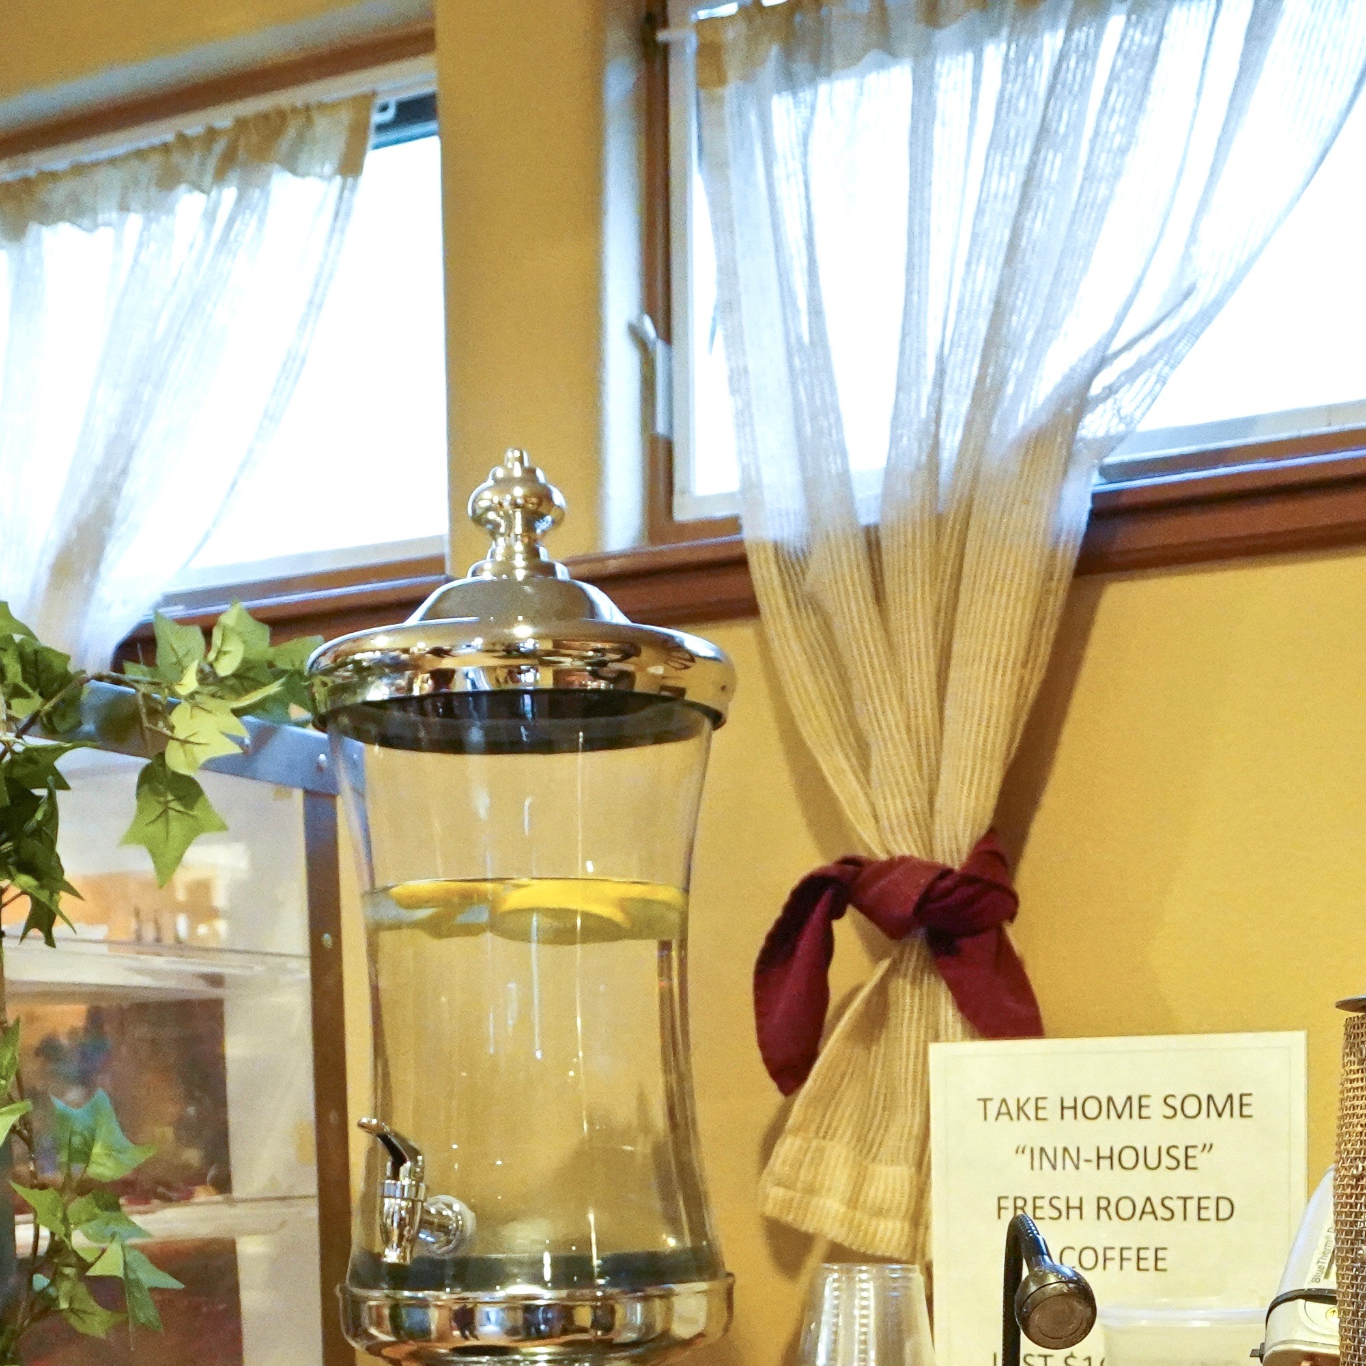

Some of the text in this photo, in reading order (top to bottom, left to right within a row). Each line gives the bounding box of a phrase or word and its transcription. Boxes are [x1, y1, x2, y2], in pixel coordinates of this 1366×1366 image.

[977, 1093, 1254, 1122] TAKE HOME SOME
[1014, 1142, 1214, 1171] “INN-HOUSE”
[997, 1195, 1235, 1222] FRESH ROASTED
[1059, 1245, 1169, 1272] COFFEE
